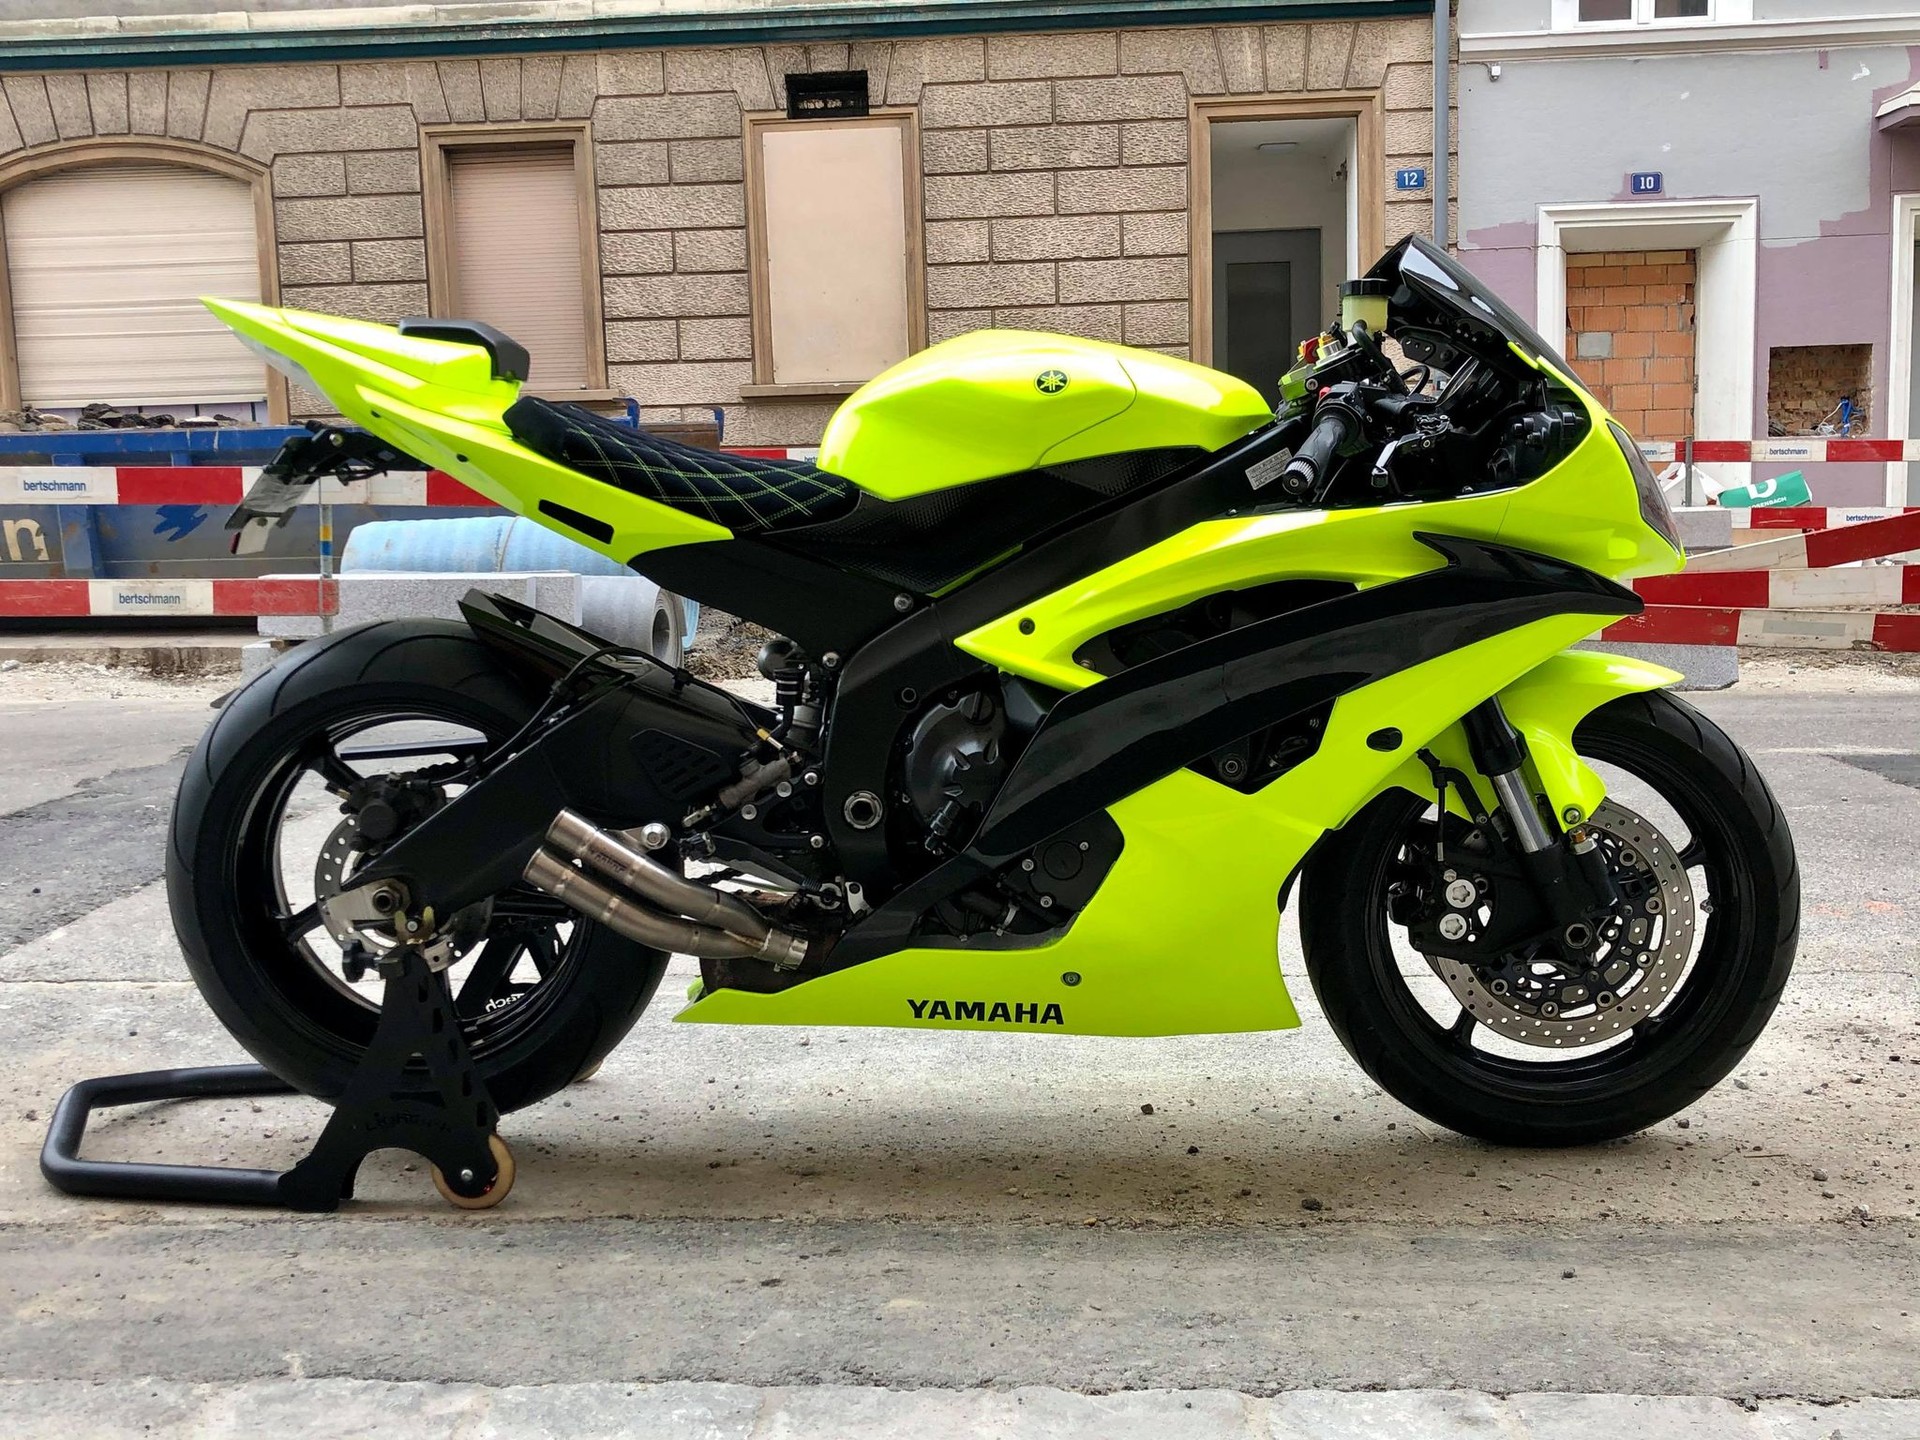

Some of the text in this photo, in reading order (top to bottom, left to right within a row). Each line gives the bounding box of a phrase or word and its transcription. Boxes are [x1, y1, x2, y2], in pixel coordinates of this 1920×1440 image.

[1403, 172, 1418, 186] 12
[1640, 176, 1655, 190] 10
[24, 480, 86, 491] bertschmann
[1748, 496, 1787, 508] OSENBACH
[0, 518, 50, 561] n
[119, 593, 181, 604] bertschmann
[906, 998, 1064, 1025] YAMAHA
